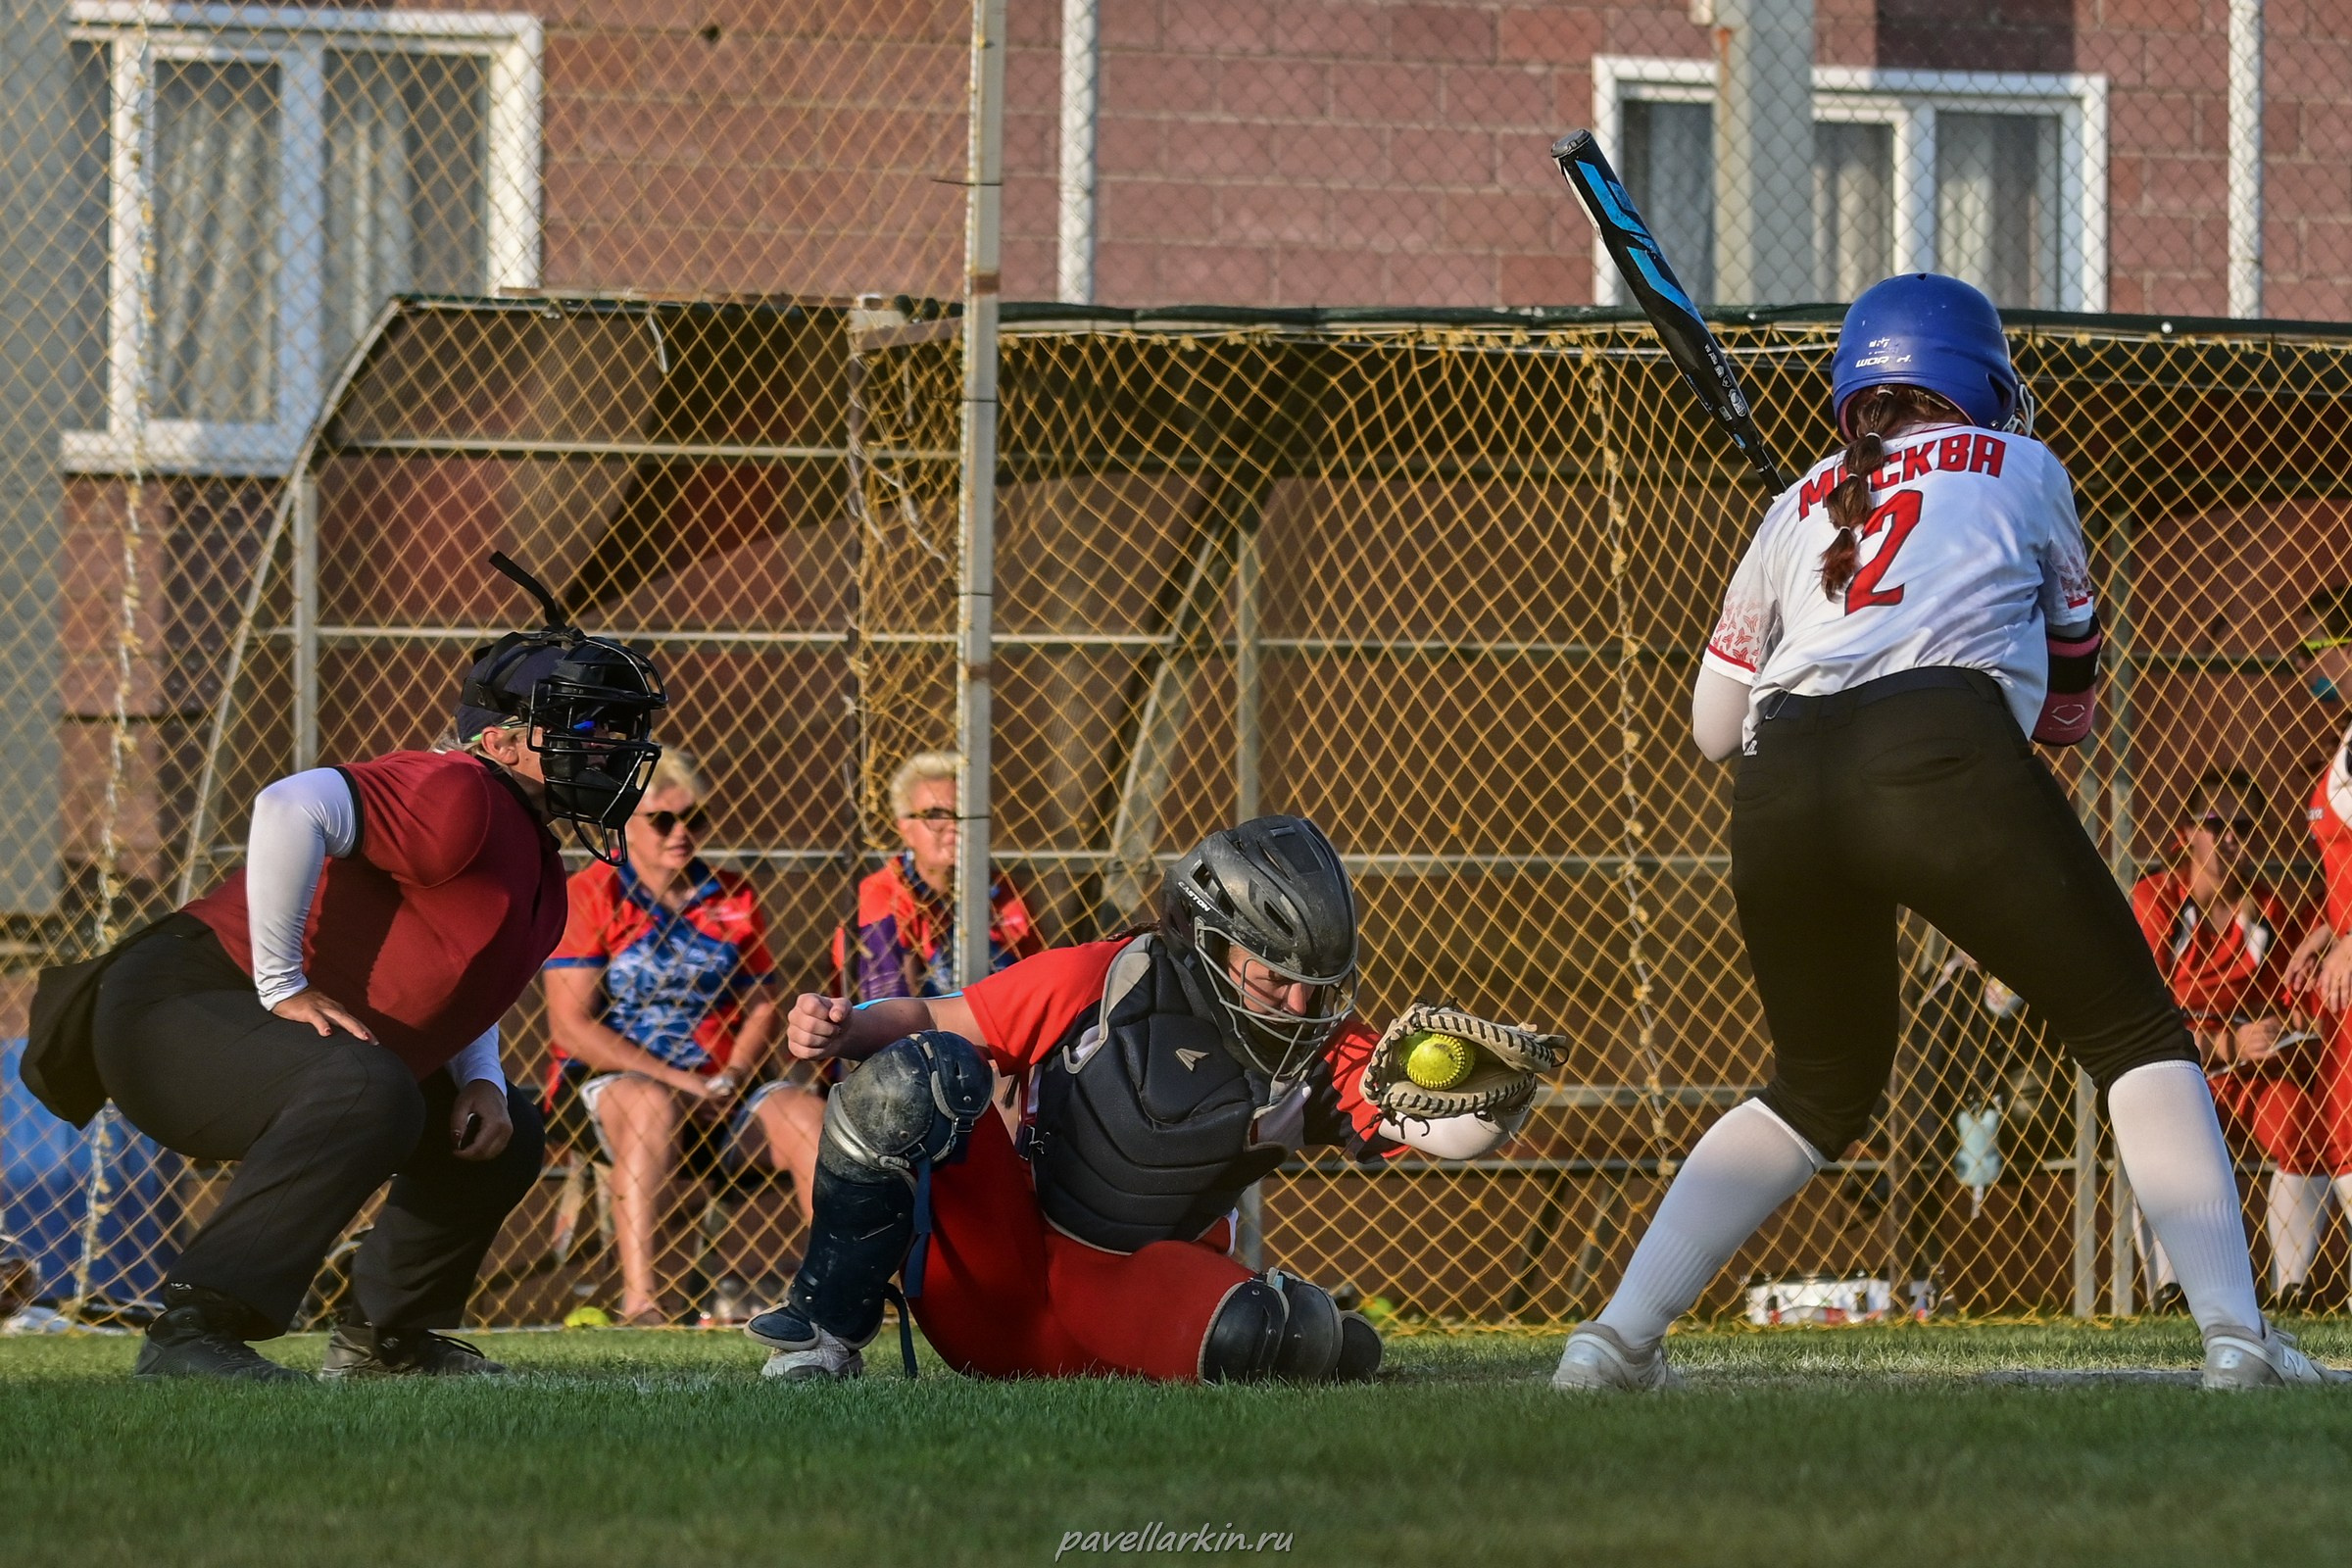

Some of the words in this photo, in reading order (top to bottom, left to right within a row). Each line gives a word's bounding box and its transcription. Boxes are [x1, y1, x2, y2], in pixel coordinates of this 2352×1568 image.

[1797, 433, 2007, 522] МСКВА
[1843, 488, 1924, 617] 2
[1177, 881, 1211, 912] EASTON
